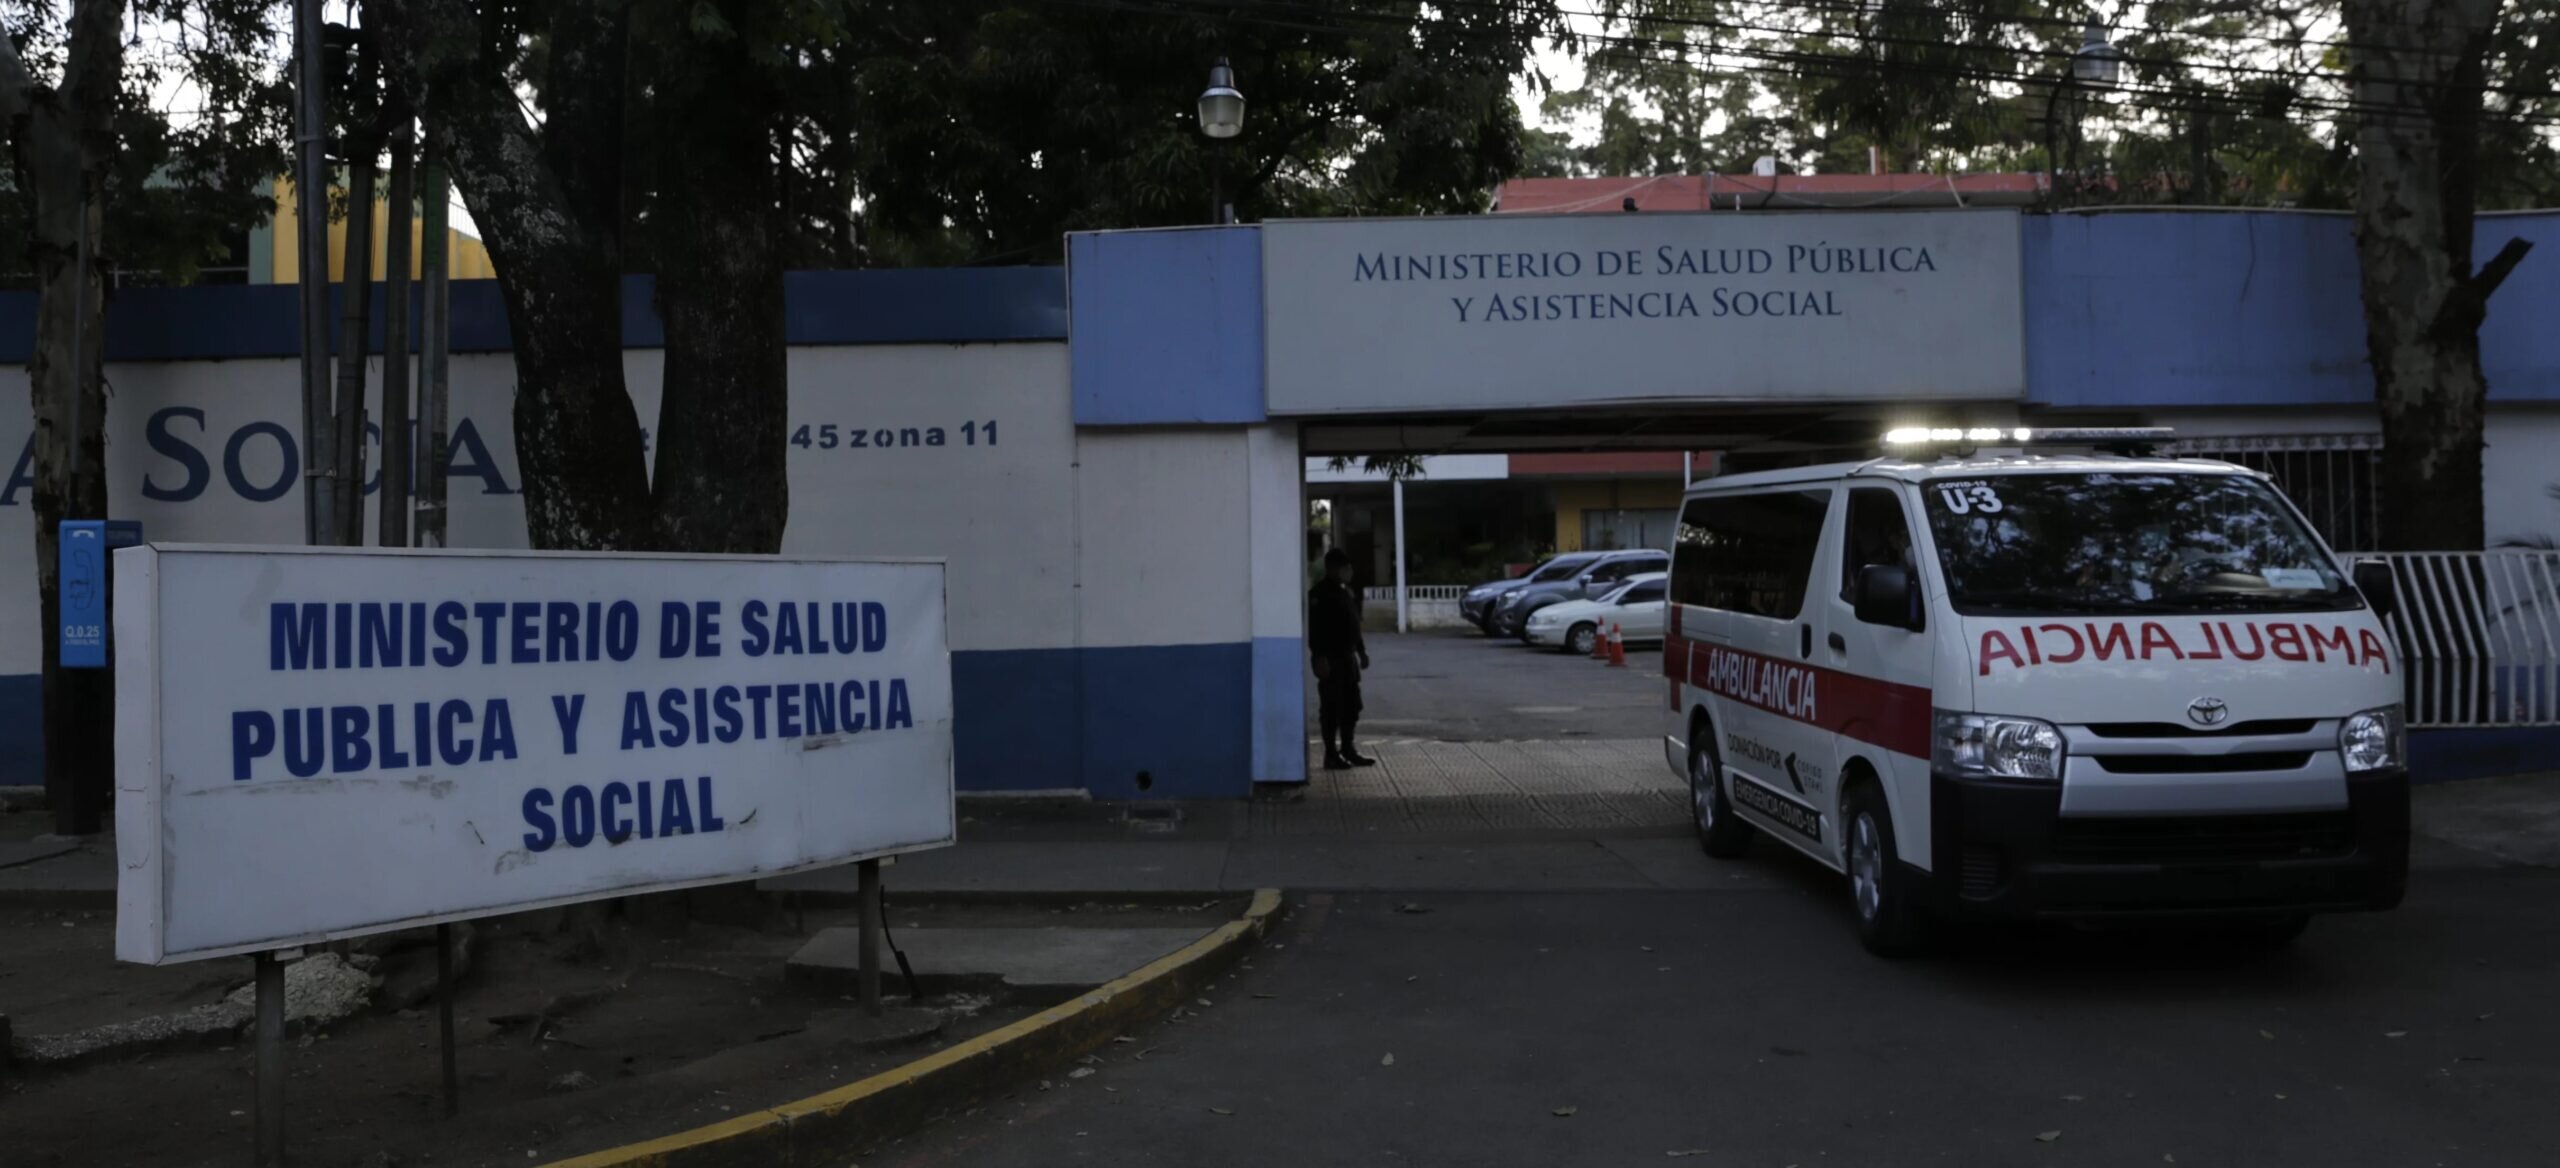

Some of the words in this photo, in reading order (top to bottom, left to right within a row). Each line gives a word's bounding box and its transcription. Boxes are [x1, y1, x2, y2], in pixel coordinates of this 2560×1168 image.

[1354, 251, 1581, 282] MINISTERIO
[1597, 250, 1642, 276] DE
[1657, 246, 1772, 275] SALUD
[1787, 241, 1936, 274] PÚBLICA
[1453, 297, 1473, 322] Y
[1485, 291, 1699, 321] ASISTENCIA
[1712, 288, 1842, 317] SOCIAL
[851, 426, 946, 448] zona
[961, 420, 998, 446] 11
[1940, 486, 2003, 515] U-3
[270, 601, 640, 671] MINISTERIO
[660, 601, 721, 660] DE
[741, 600, 887, 657] SALUD
[1707, 648, 1817, 721] AMBULANCIA
[232, 698, 518, 781] PUBLICA
[552, 694, 585, 754] Y
[621, 678, 912, 750] ASISTENCIA
[522, 777, 723, 852] SOCIAL
